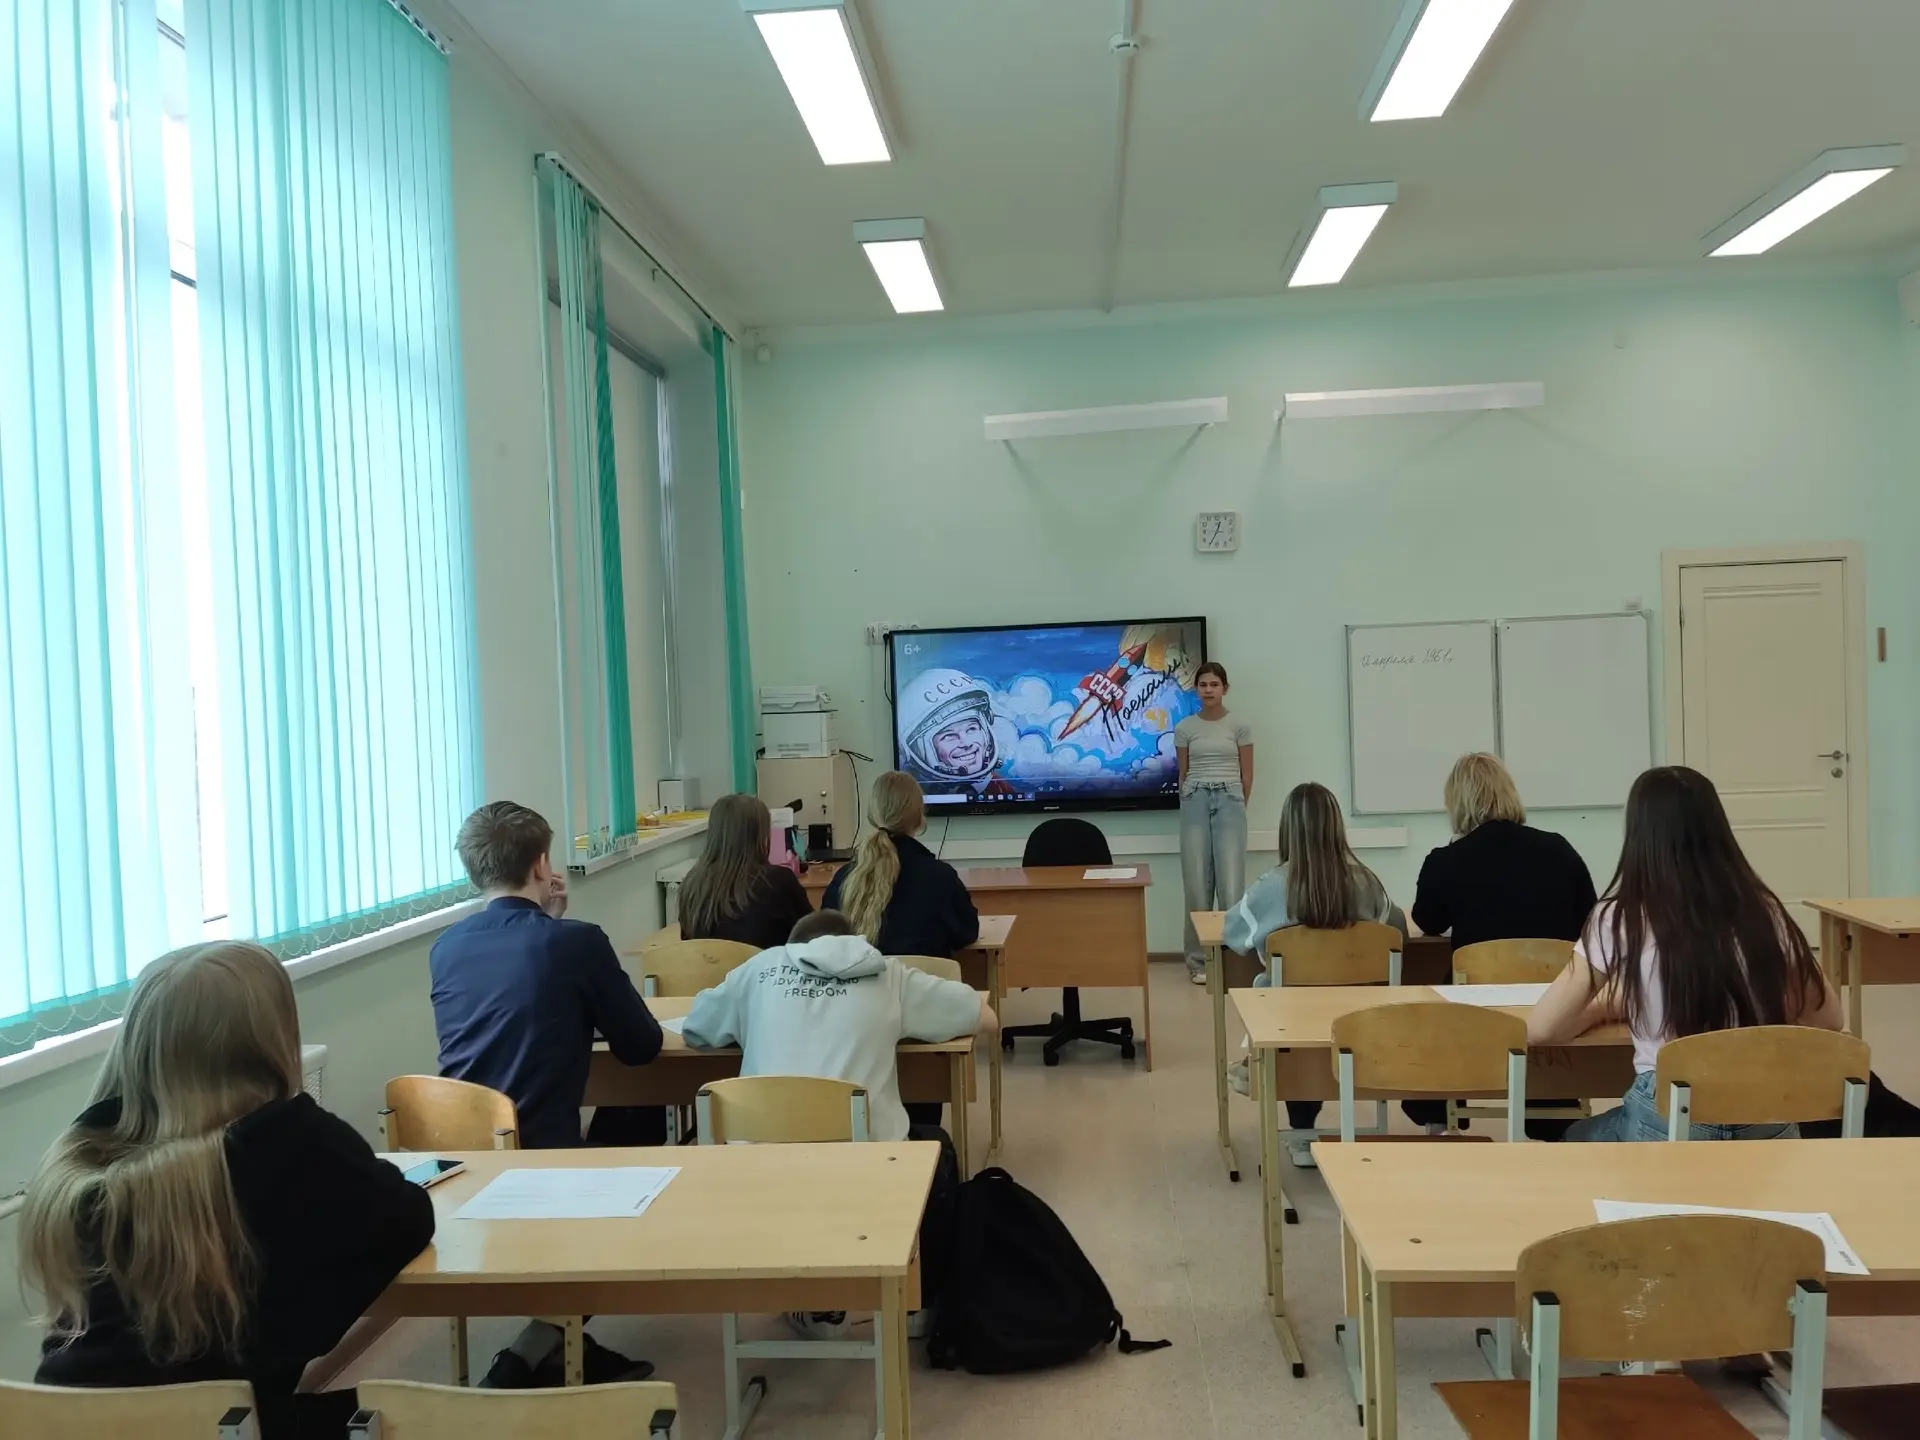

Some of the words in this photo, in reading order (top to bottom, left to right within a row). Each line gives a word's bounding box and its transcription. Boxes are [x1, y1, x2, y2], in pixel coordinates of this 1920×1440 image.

[904, 643, 922, 655] 6+
[1088, 672, 1125, 703] СССР
[785, 987, 848, 999] FREEDOM
